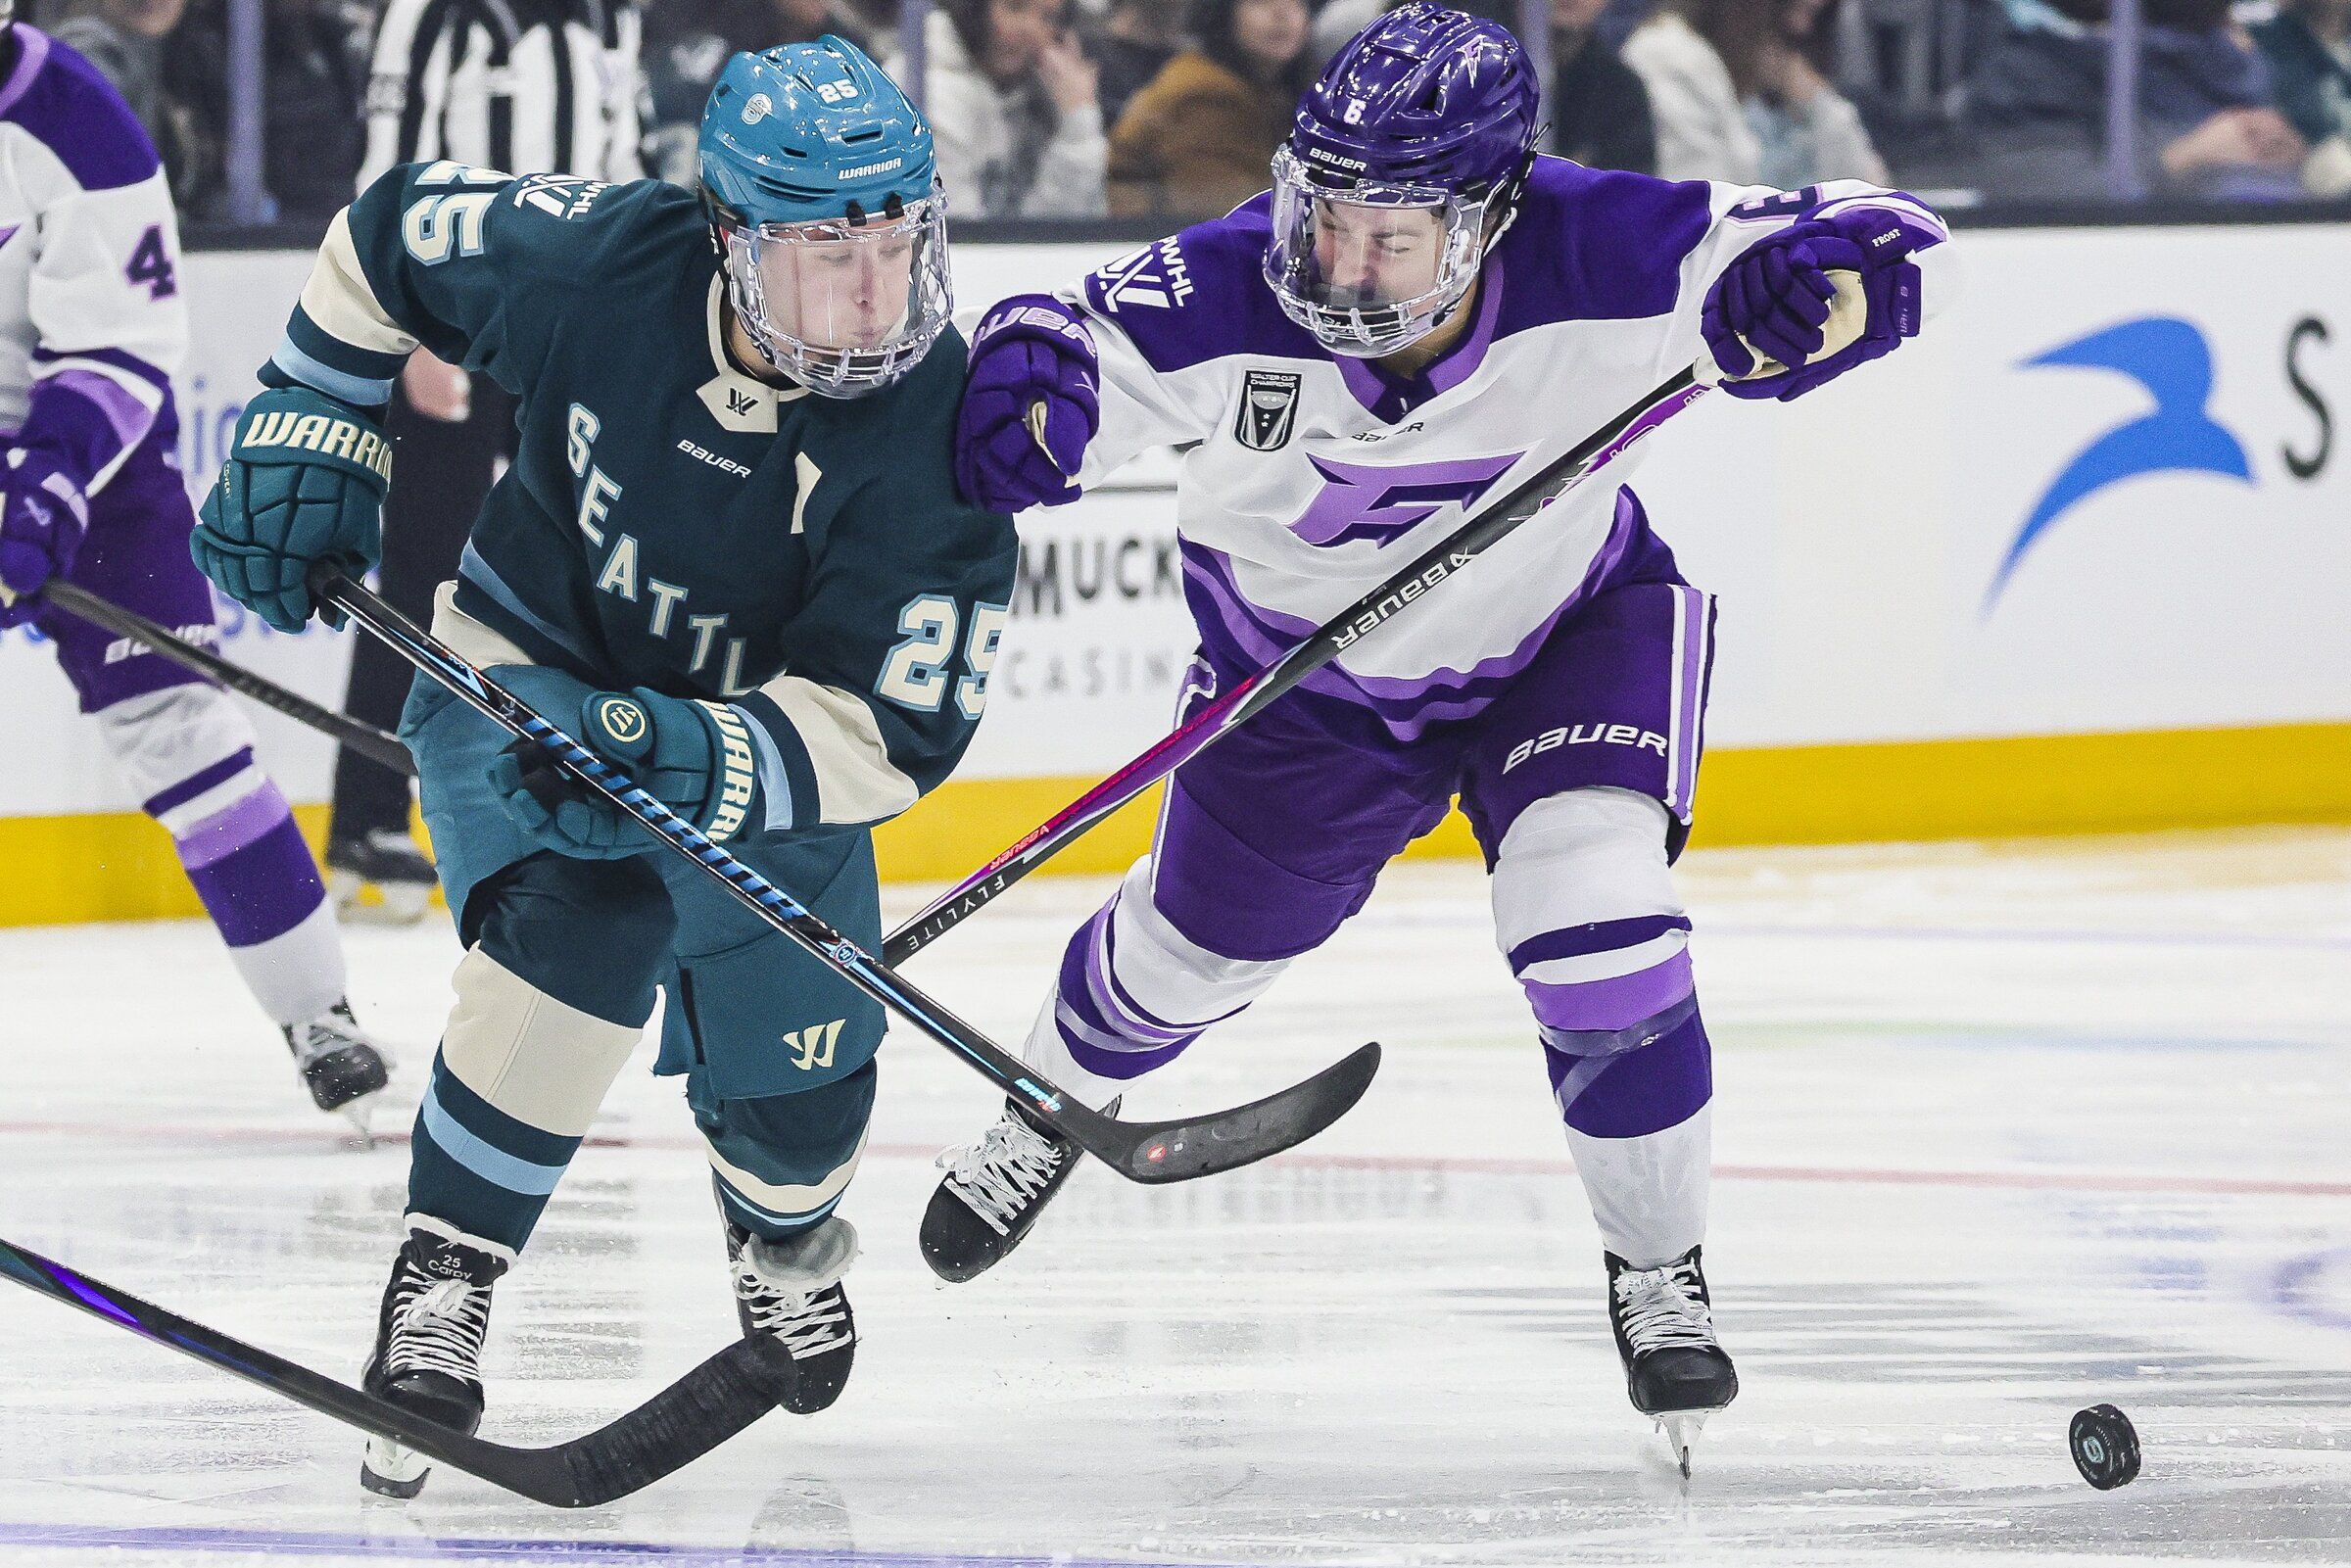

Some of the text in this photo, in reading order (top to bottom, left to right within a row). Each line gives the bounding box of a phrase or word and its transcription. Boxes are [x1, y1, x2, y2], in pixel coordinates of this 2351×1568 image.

[816, 78, 859, 104] 25
[1343, 98, 1367, 124] 6
[838, 157, 903, 180] WARRIOR
[1872, 228, 1900, 247] FROST
[124, 223, 177, 302] 4
[2284, 317, 2332, 479] S
[567, 403, 760, 697] SEATTL
[1002, 648, 1175, 699] CASIN
[907, 875, 1006, 950] FLYLITE
[442, 1254, 460, 1268] 25
